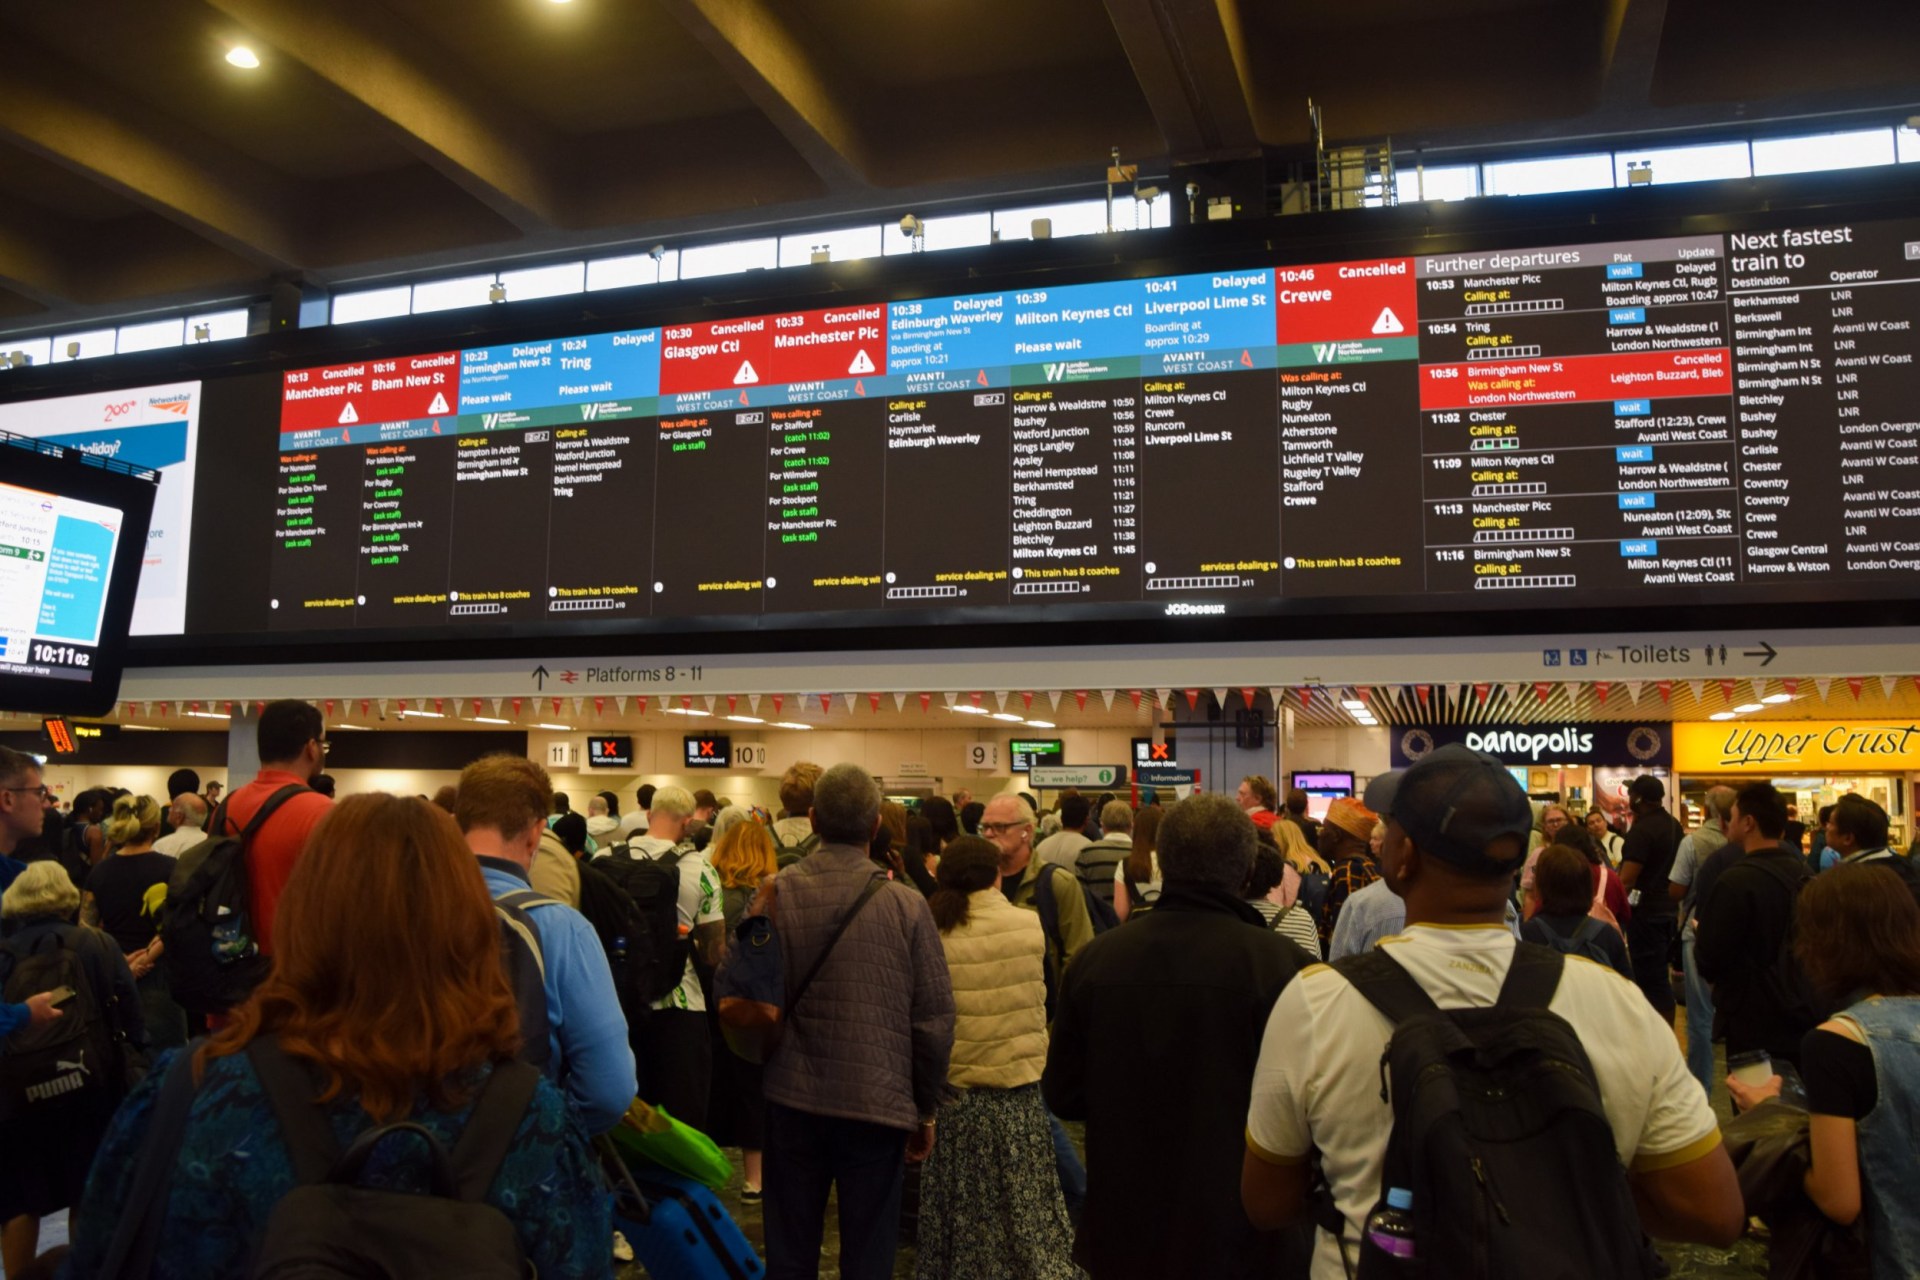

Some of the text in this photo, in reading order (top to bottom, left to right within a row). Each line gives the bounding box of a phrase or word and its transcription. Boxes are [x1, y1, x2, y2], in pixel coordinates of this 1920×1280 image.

[1730, 226, 1852, 250] Next fastest
[1613, 253, 1632, 262] Plat
[1676, 247, 1717, 260] Update
[1425, 251, 1582, 273] Further departures
[1675, 261, 1716, 274] Delayed
[1731, 252, 1804, 272] train to
[1279, 268, 1314, 282] 10:46
[1338, 261, 1405, 278] Cancelled
[1212, 272, 1265, 288] Delayed
[1463, 274, 1540, 287] Manchester Picc
[1731, 275, 1789, 288] Destination
[1829, 269, 1881, 284] Operator
[1144, 280, 1176, 293] 10:41
[1426, 279, 1454, 290] 10:53
[1015, 291, 1047, 304] 10:39
[1280, 289, 1331, 303] Crewe
[1733, 293, 1799, 307] Berkhamsted
[1830, 289, 1852, 300] LNR
[892, 303, 922, 316] 10:38
[953, 295, 1002, 311] Delayed
[1145, 293, 1266, 315] Liverpool Lime St
[823, 307, 880, 323] Cancelled
[891, 310, 1003, 330] Edinburgh Waverley
[1015, 303, 1132, 325] Milton Keynes Ctl
[1734, 311, 1781, 323] Berkswell
[710, 319, 763, 335] Cancelled
[775, 315, 803, 328] 10:33
[1144, 320, 1201, 333] Boarding at
[1465, 322, 1490, 333] Tring
[665, 327, 692, 339] 10:30
[1428, 323, 1456, 334] 10:54
[613, 331, 654, 346] Delayed
[774, 326, 878, 347] Manchester Pic
[1144, 332, 1209, 349] approx 10:29
[512, 343, 551, 357] Delayed
[561, 339, 586, 351] 10:24
[664, 339, 739, 359] Glasgow Ctl
[890, 342, 942, 354] Boarding at
[1015, 338, 1081, 353] Please wait
[410, 354, 455, 369] Cancelled
[464, 350, 488, 362] 10:23
[890, 353, 948, 369] approx 10:21
[1162, 351, 1204, 362] AVANTI
[1673, 353, 1721, 365] Cancelled
[372, 361, 395, 373] 10:16
[463, 356, 550, 374] Birmingham New St
[560, 356, 591, 370] Tring
[1162, 359, 1235, 373] WEST COAST
[1467, 362, 1562, 377] Birmingham New St
[287, 372, 308, 383] 10:13
[322, 365, 364, 379] Cancelled
[906, 371, 944, 382] AVANTI
[1429, 367, 1458, 378] 10:56
[371, 372, 444, 390] Bham New St
[786, 380, 824, 392] AVANTI
[906, 379, 973, 392] WEST COAST
[285, 381, 362, 400] Manchester Pic
[558, 381, 612, 395] Please wait
[461, 391, 511, 405] Please wait
[674, 391, 710, 402] AVANTI
[787, 389, 851, 403] WEST COAST
[676, 399, 735, 413] WEST COAST
[1281, 398, 1312, 411] Rugby
[888, 411, 920, 423] Carlisle
[1013, 416, 1046, 427] Bushey
[1282, 412, 1331, 423] Nuneaton
[1431, 412, 1460, 423] 11:02
[1469, 411, 1506, 421] Chester
[378, 420, 409, 430] AVANTI
[888, 423, 935, 437] Haymarket
[1144, 421, 1185, 431] Runcorn
[1281, 426, 1337, 437] Atherstone
[380, 427, 430, 440] WEST COAST
[1432, 457, 1461, 469] 11:09
[1742, 461, 1781, 471] Chester
[553, 472, 602, 484] Berkhamsted
[1283, 480, 1323, 492] Stafford
[1012, 507, 1072, 519] Cheddington
[1434, 503, 1463, 514] 11:13
[1012, 533, 1054, 545] Bletchley
[1112, 544, 1135, 554] 11:45
[1435, 549, 1464, 560] 11:16
[1746, 543, 1827, 558] Glasgow Central
[1296, 555, 1400, 568] This train has 8 coaches
[34, 644, 89, 666] 10:11 02
[1617, 645, 1691, 663] Toilets
[11, 664, 33, 676] appear
[34, 665, 50, 675] here
[586, 666, 660, 682] Platforms
[665, 665, 676, 680] 8
[690, 664, 702, 680] 11
[76, 726, 89, 738] Way
[1720, 724, 1920, 765] Upper Crust
[552, 746, 562, 761] 11
[570, 747, 579, 762] 11
[735, 746, 752, 763] 10
[756, 747, 765, 764] 10
[972, 746, 984, 764] 9
[1137, 760, 1177, 768] Platform close
[1065, 774, 1089, 785] help?
[1150, 774, 1191, 783] Information
[25, 1070, 84, 1103] PUMA
